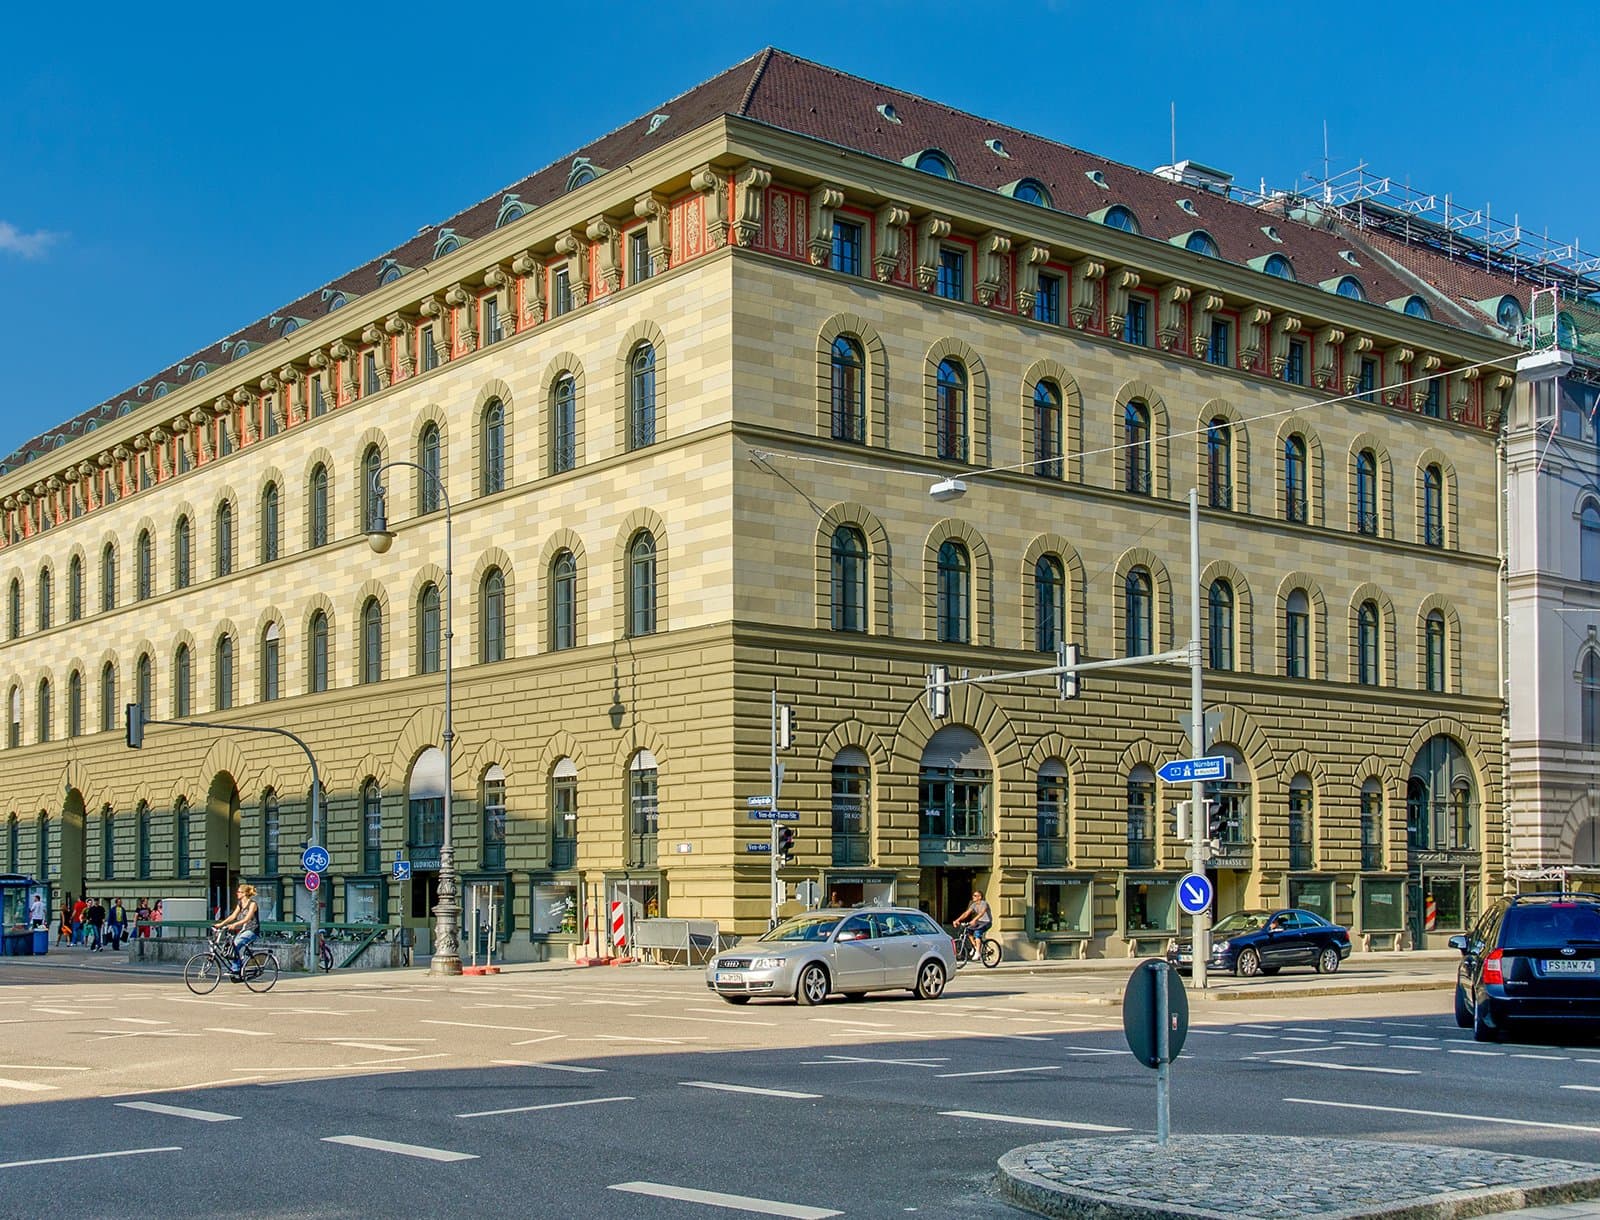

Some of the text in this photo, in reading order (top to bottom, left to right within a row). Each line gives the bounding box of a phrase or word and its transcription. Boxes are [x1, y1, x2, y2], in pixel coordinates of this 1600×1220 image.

[1193, 760, 1220, 769] Nürnberg
[413, 860, 441, 869] LUDWIGSTR
[1548, 961, 1592, 970] FS AW 74
